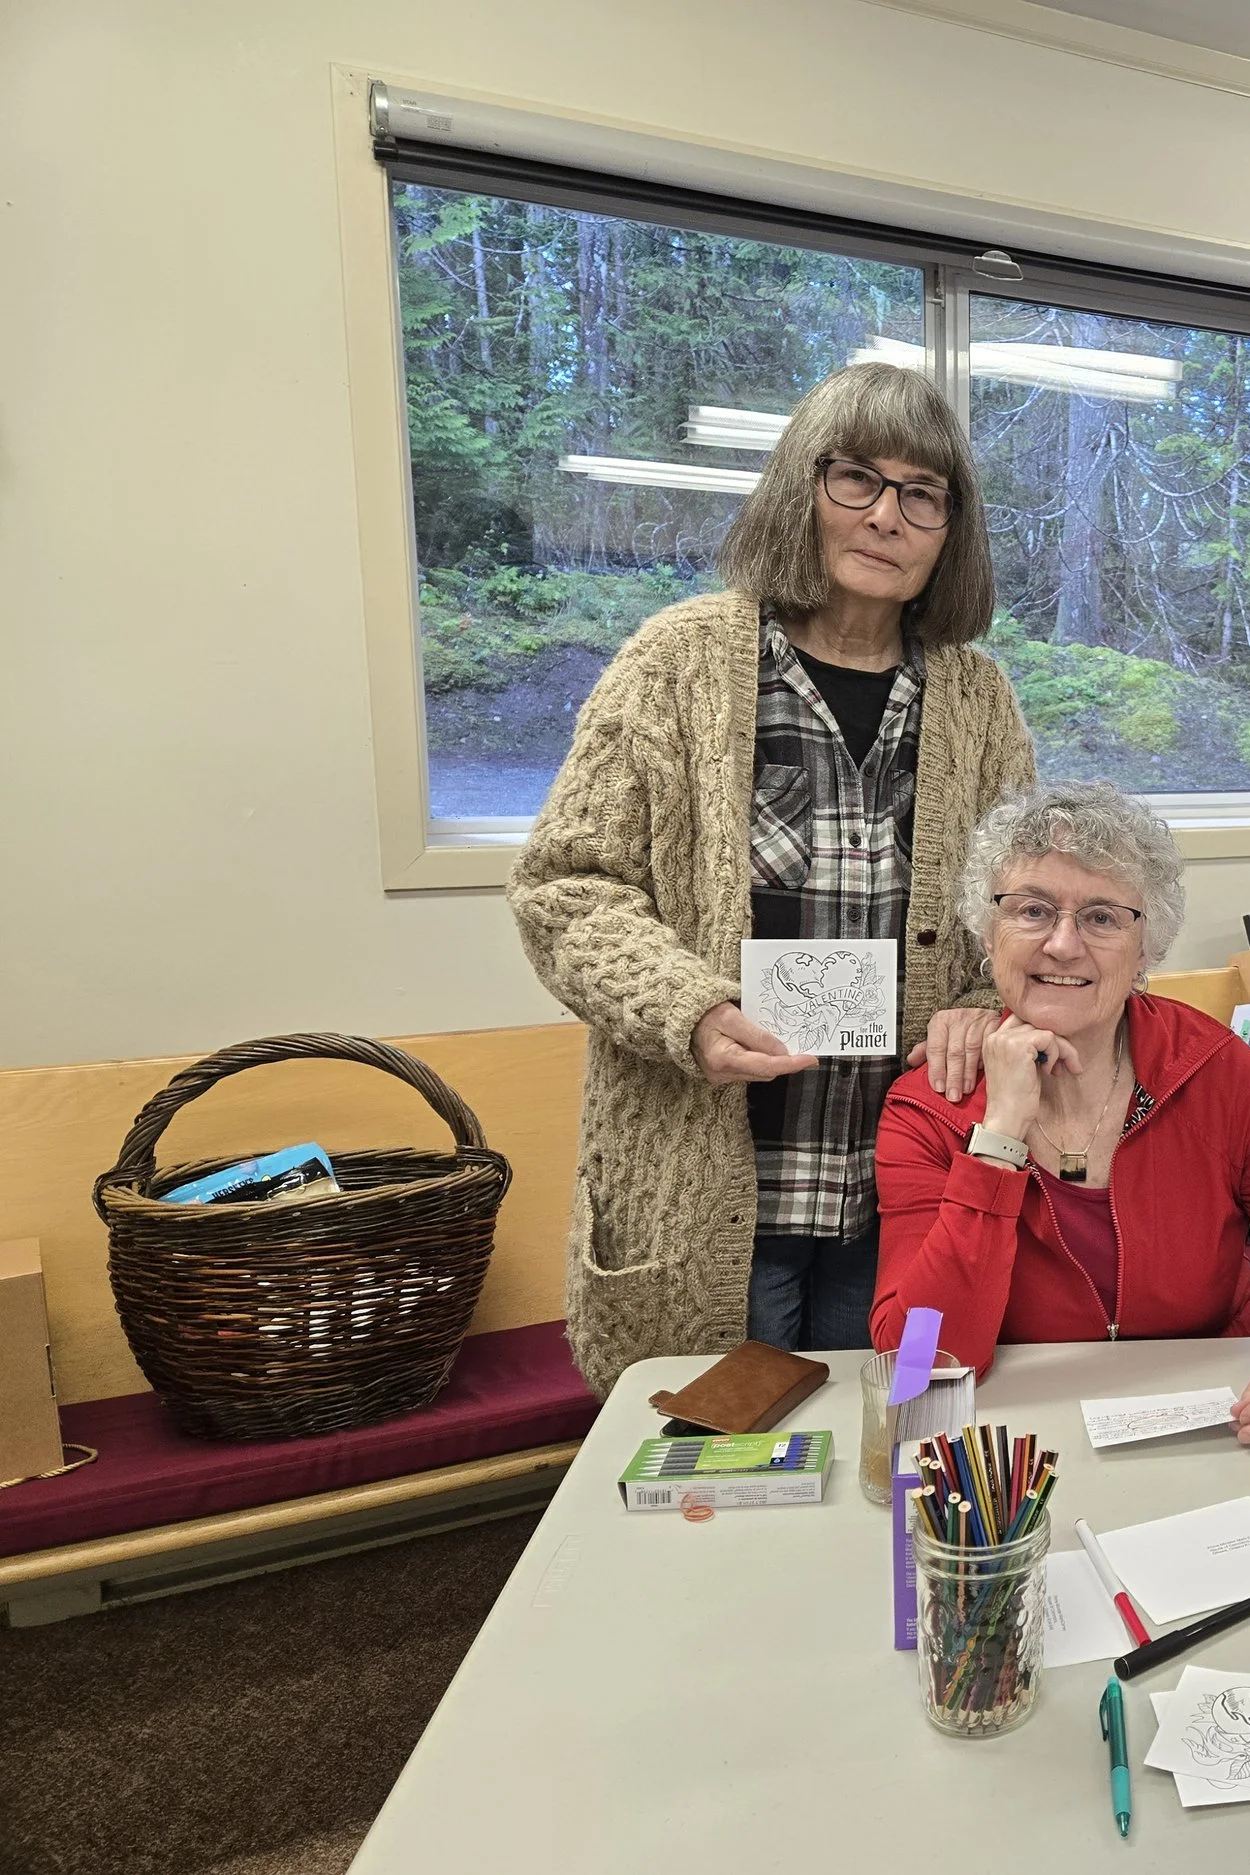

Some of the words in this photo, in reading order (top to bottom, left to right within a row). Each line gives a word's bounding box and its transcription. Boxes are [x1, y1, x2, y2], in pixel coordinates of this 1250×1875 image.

[798, 990, 863, 1014] VALENTINE
[869, 1022, 883, 1034] the
[840, 1030, 887, 1050] Planet
